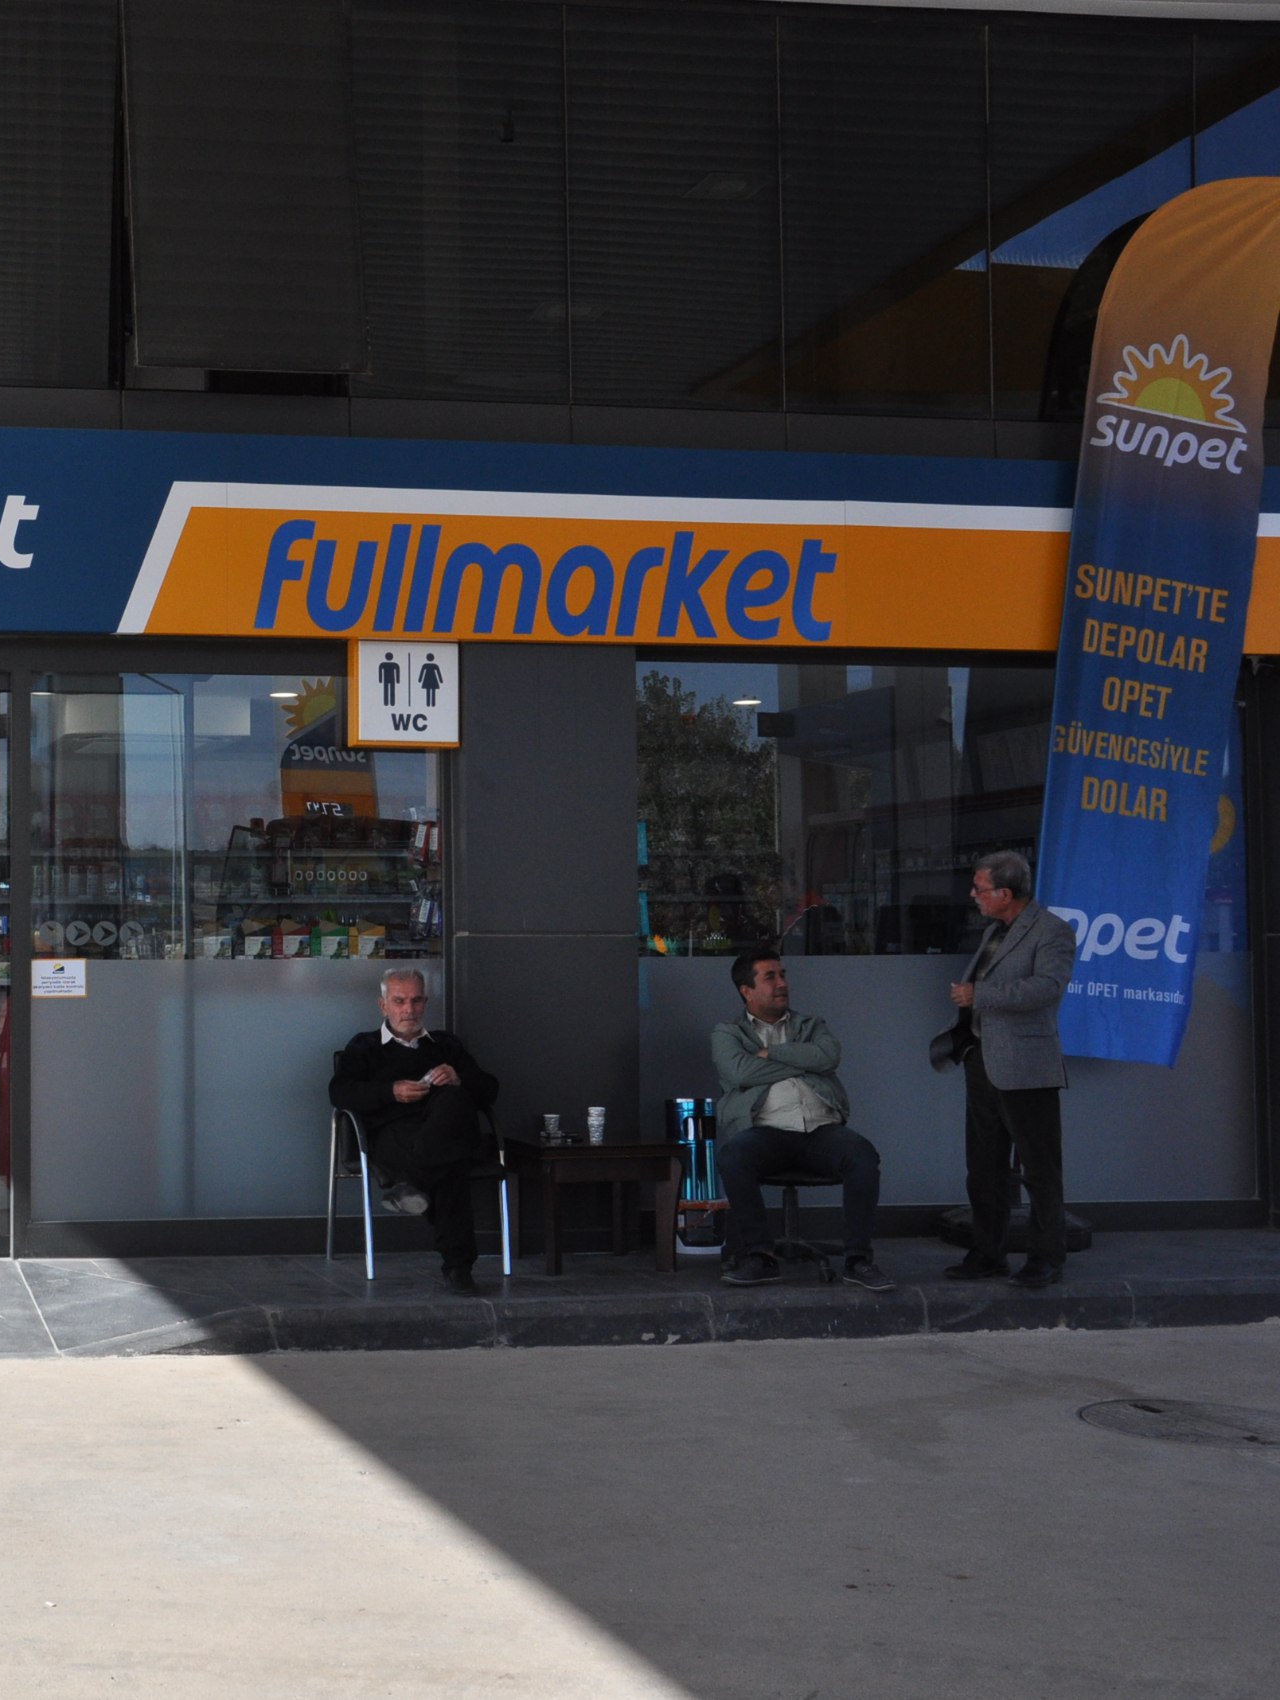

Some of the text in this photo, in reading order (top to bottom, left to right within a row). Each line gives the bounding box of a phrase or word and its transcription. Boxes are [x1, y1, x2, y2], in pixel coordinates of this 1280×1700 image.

[1090, 413, 1248, 474] sunpet
[253, 519, 838, 642] fullmarket
[1074, 563, 1229, 623] SUNPET'TE
[1082, 618, 1209, 673] DEPOLAR
[391, 713, 429, 732] WC
[1101, 676, 1173, 720] OPET
[1080, 775, 1168, 823] DOLAR
[1087, 981, 1119, 999] OPET
